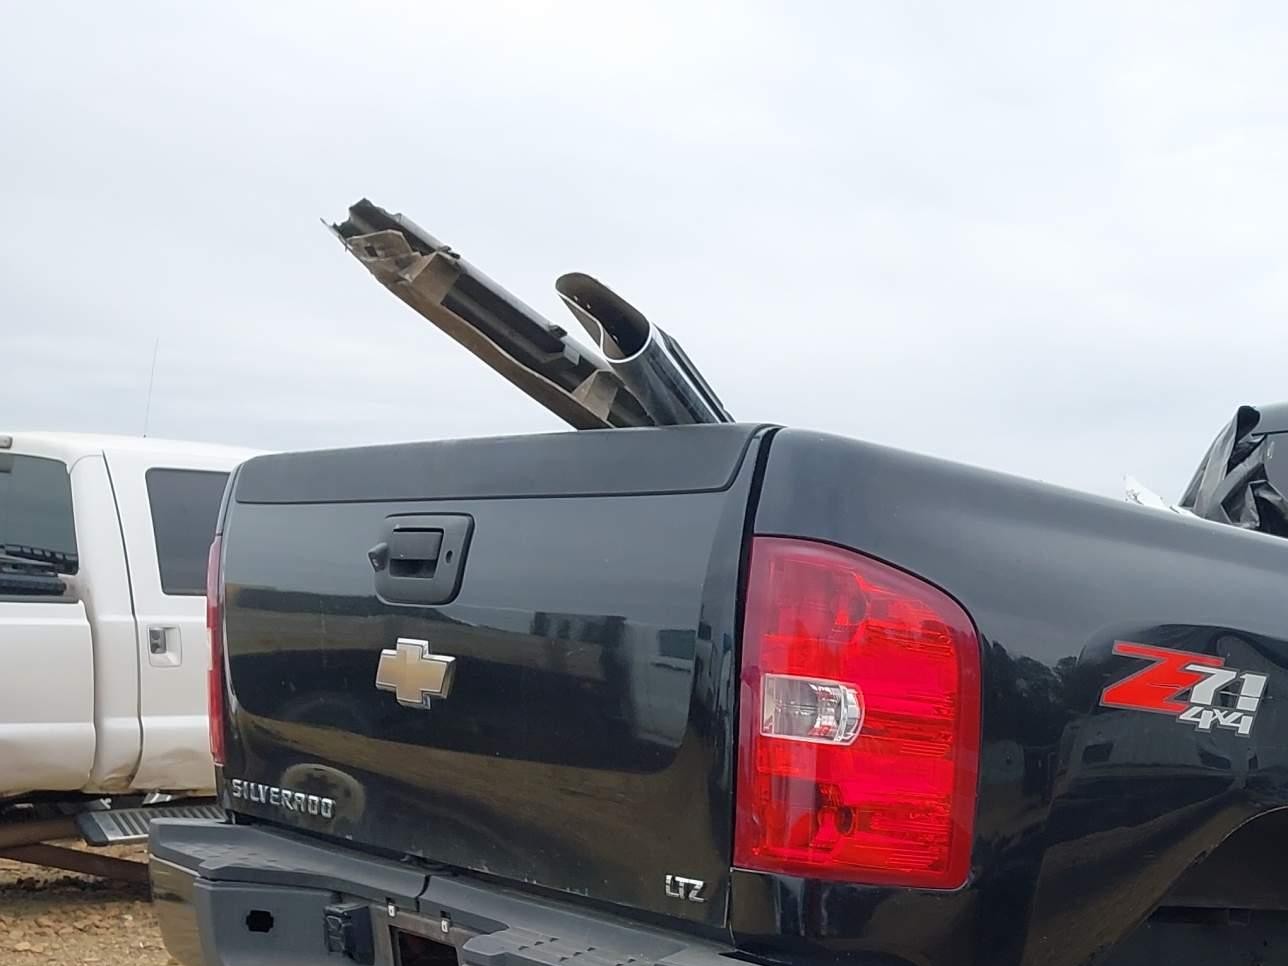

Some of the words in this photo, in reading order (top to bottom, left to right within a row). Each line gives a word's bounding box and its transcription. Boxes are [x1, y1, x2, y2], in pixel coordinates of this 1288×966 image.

[1100, 640, 1269, 715] Z71
[231, 778, 335, 819] SILVERADO
[665, 874, 705, 902] LTZ
